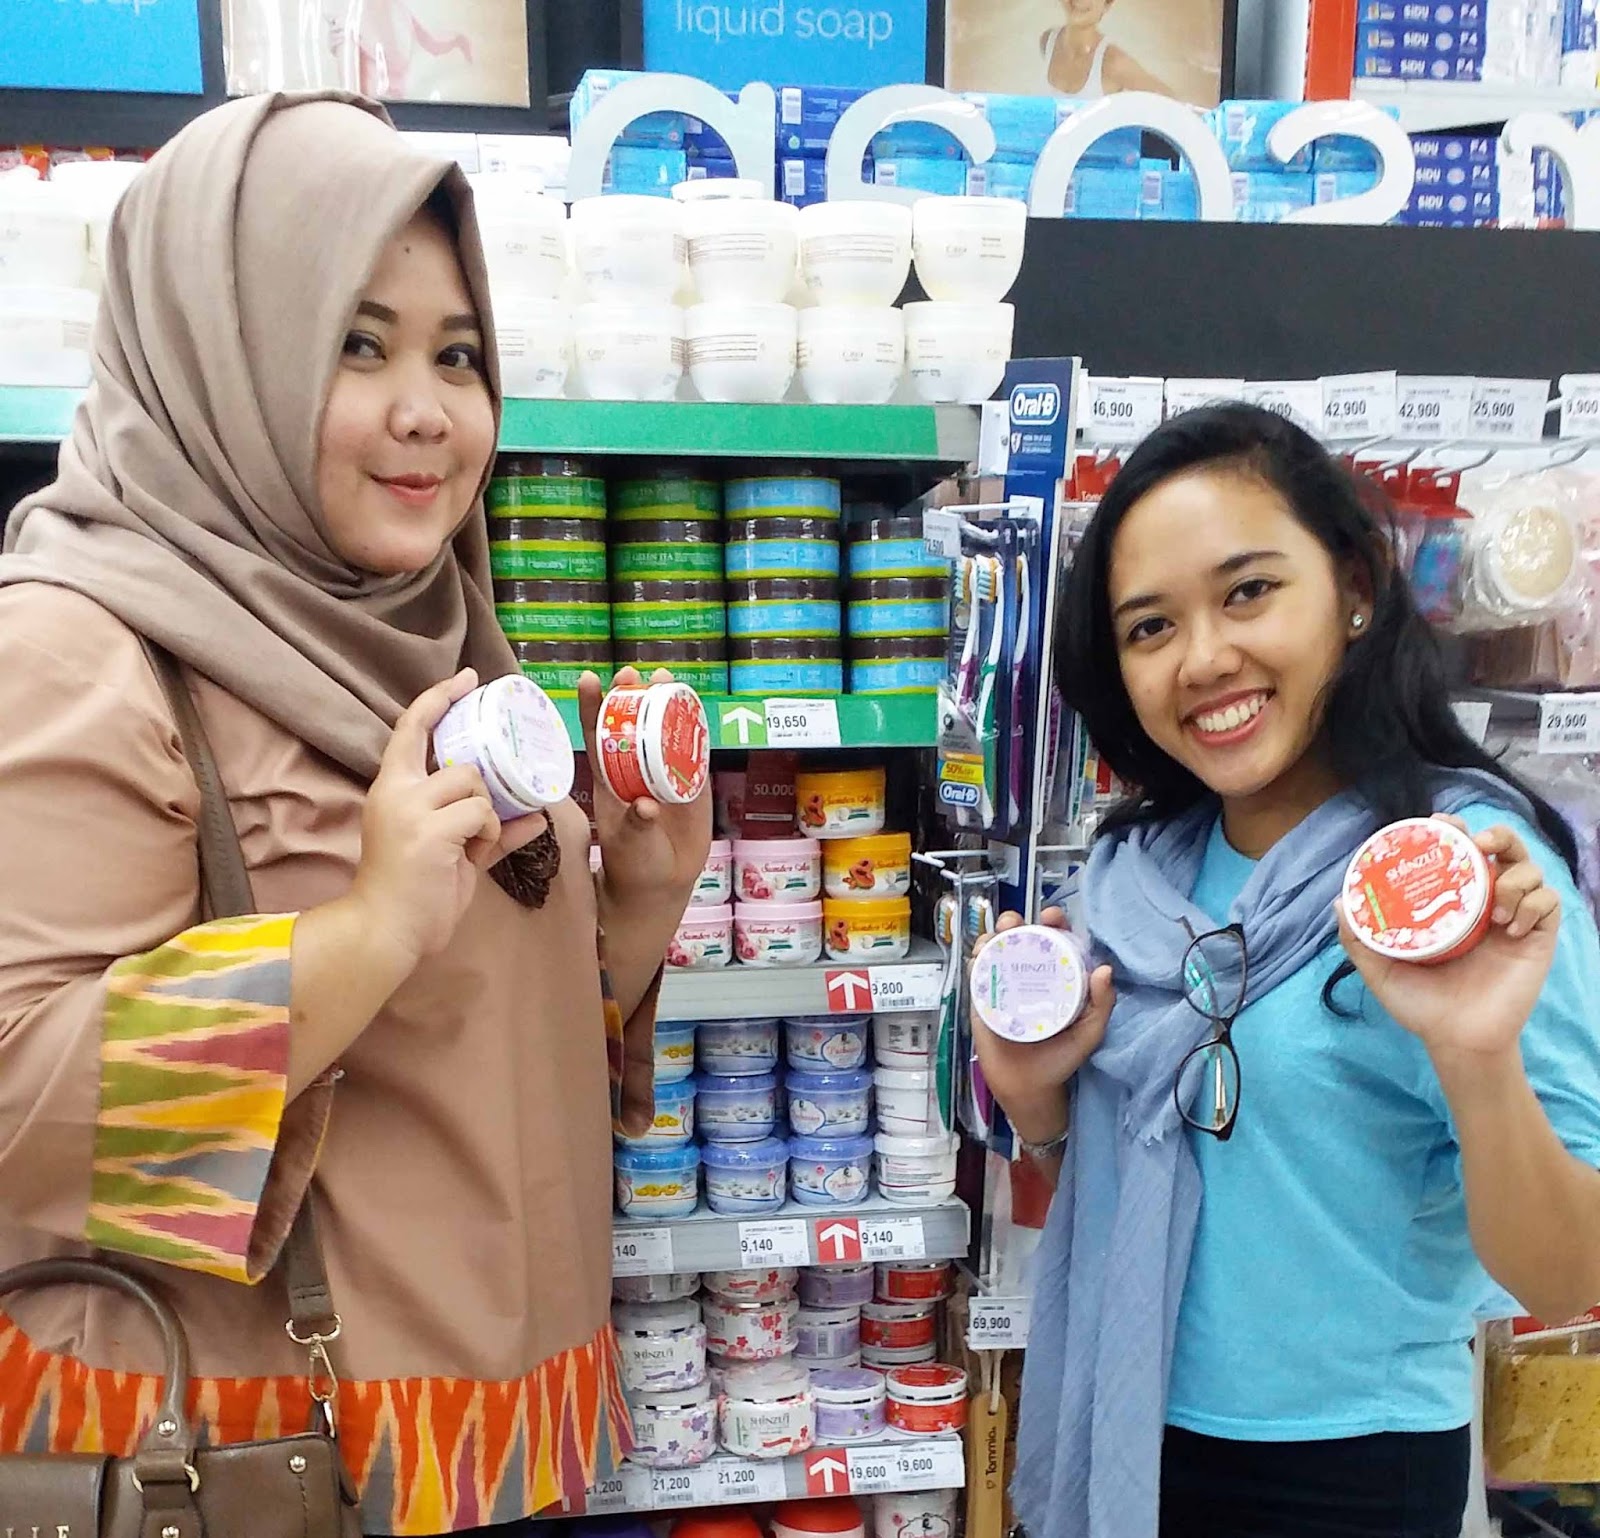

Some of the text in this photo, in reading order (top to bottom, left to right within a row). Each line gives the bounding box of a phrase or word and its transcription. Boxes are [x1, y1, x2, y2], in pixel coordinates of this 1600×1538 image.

[1460, 3, 1478, 19] F4
[676, 0, 894, 49] liquid soap
[1460, 31, 1478, 47] F4
[1456, 57, 1474, 73] F4
[1470, 139, 1488, 154] F4
[1472, 165, 1490, 180] F4
[1474, 192, 1491, 208] F4
[1014, 393, 1056, 416] Oral-B
[1325, 400, 1367, 417] 42,900
[1399, 402, 1440, 418] 42,900
[1474, 402, 1515, 418] 25,900
[766, 714, 807, 730] 19,650
[1547, 714, 1588, 730] 29,900
[943, 785, 977, 803] Oral-B
[872, 982, 903, 996] 9,800
[741, 1238, 774, 1254] 9,140
[862, 1230, 893, 1246] 9,140
[973, 1316, 1011, 1331] 69,900
[850, 1465, 887, 1481] 19,600
[897, 1458, 934, 1473] 19,600
[652, 1476, 691, 1492] 21,200
